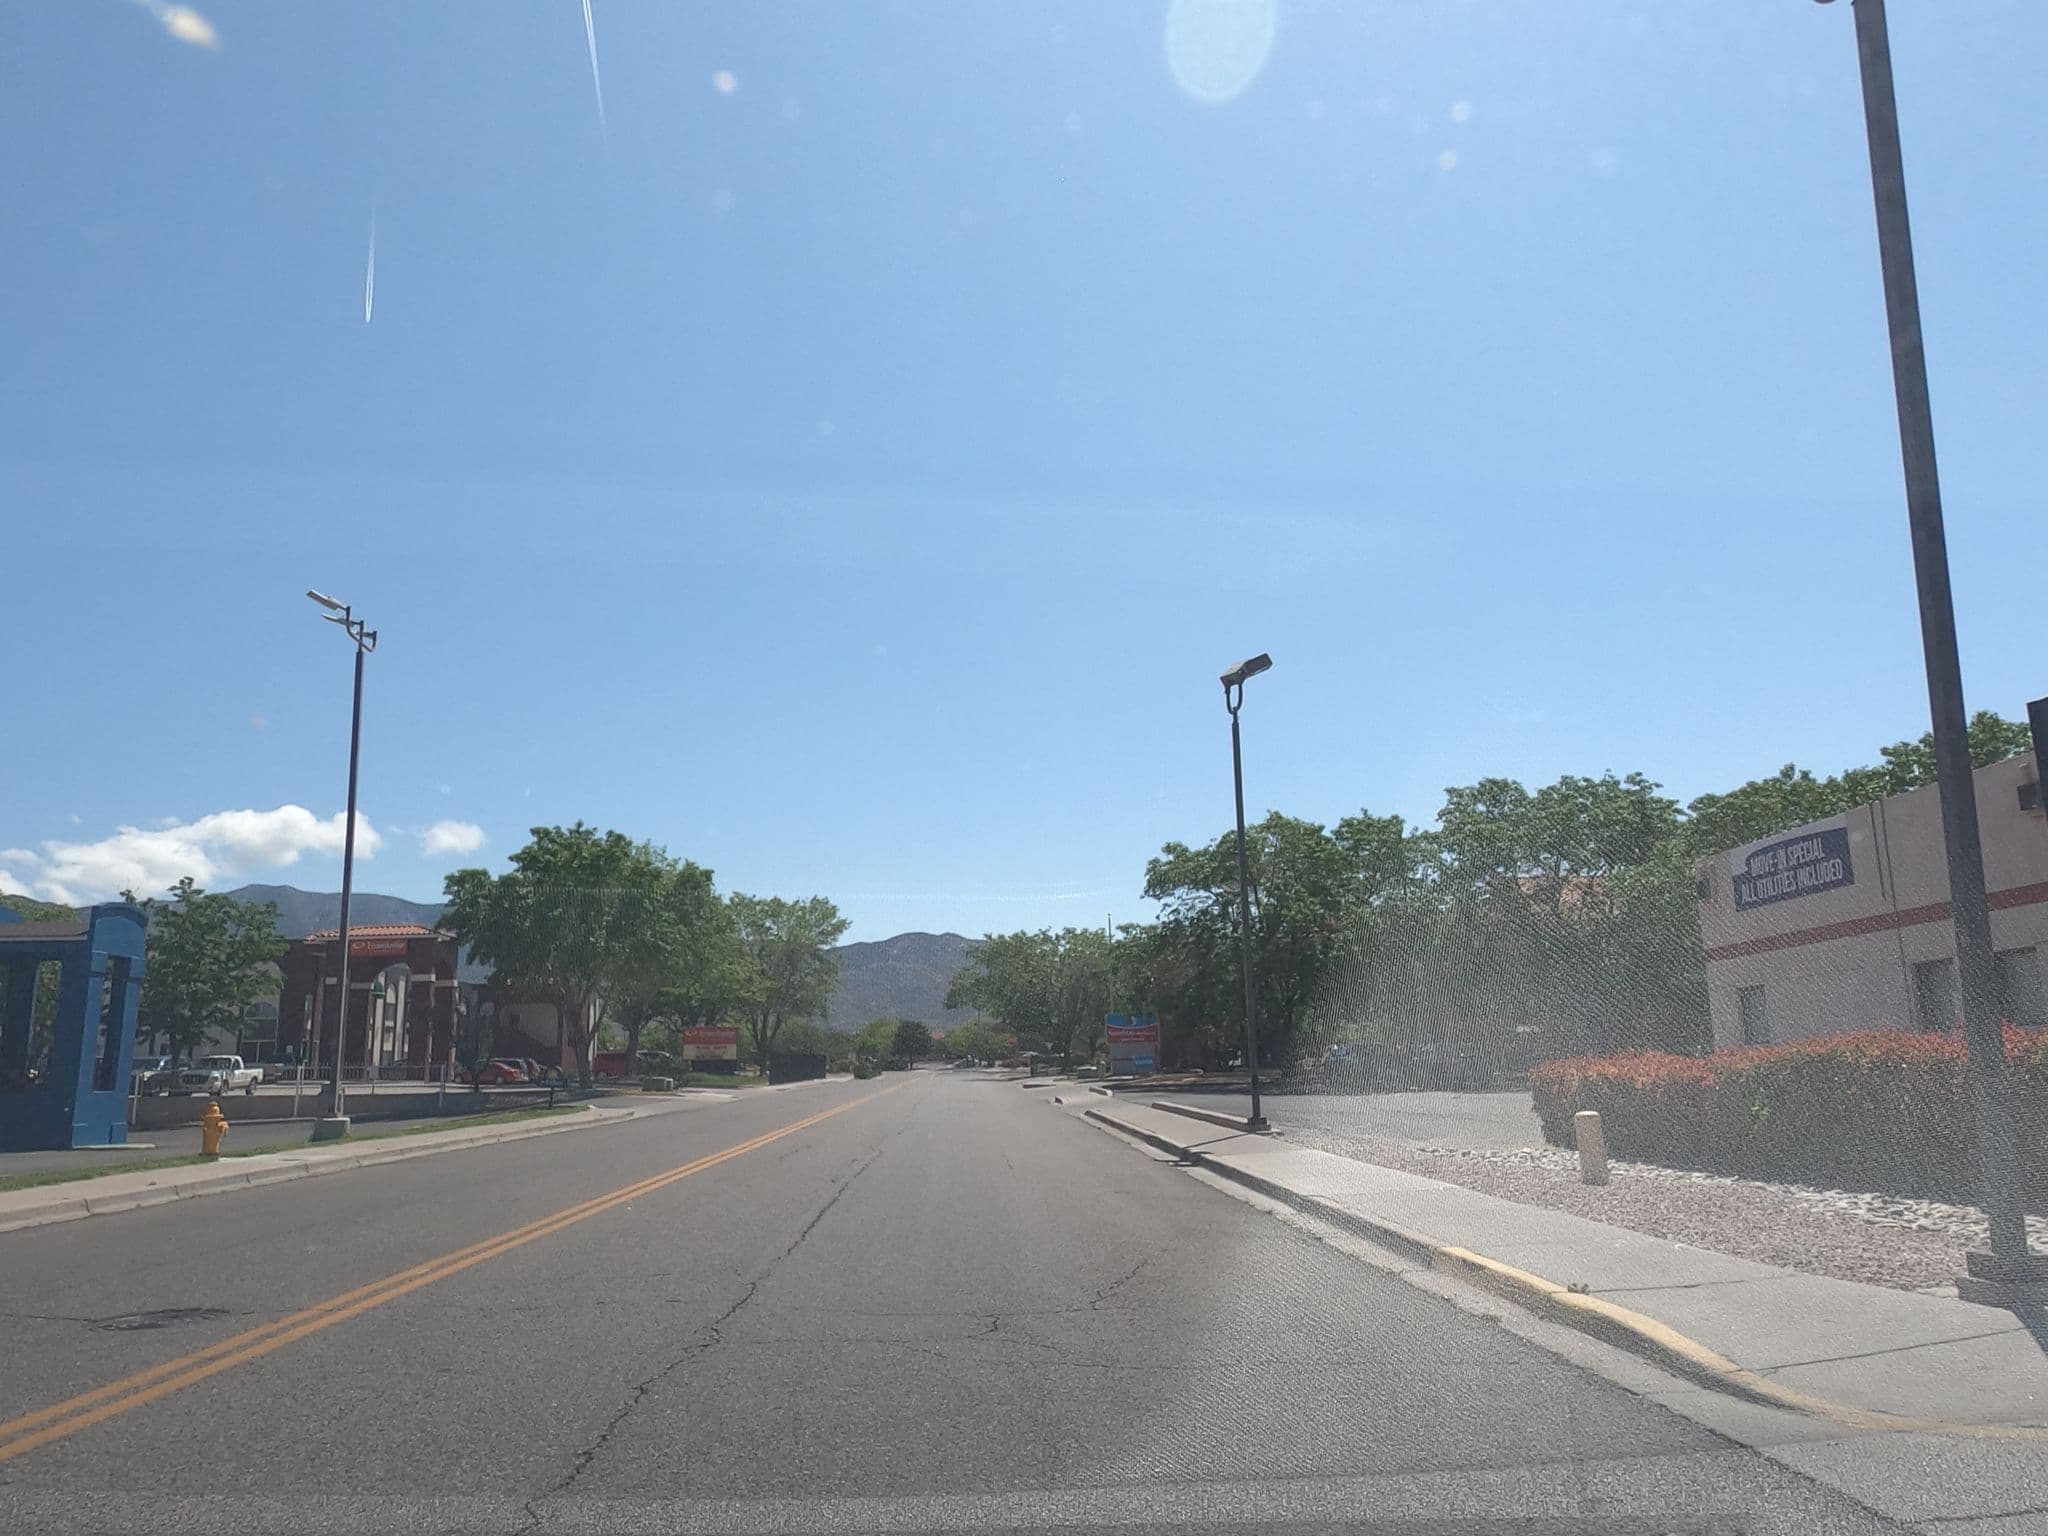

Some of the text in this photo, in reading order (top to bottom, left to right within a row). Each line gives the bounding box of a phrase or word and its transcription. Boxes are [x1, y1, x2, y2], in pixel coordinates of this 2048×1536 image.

[1750, 837, 1825, 877] MOVE-IN SPECIAL
[1742, 858, 1843, 903] ALL UTILITIES INCLUDED
